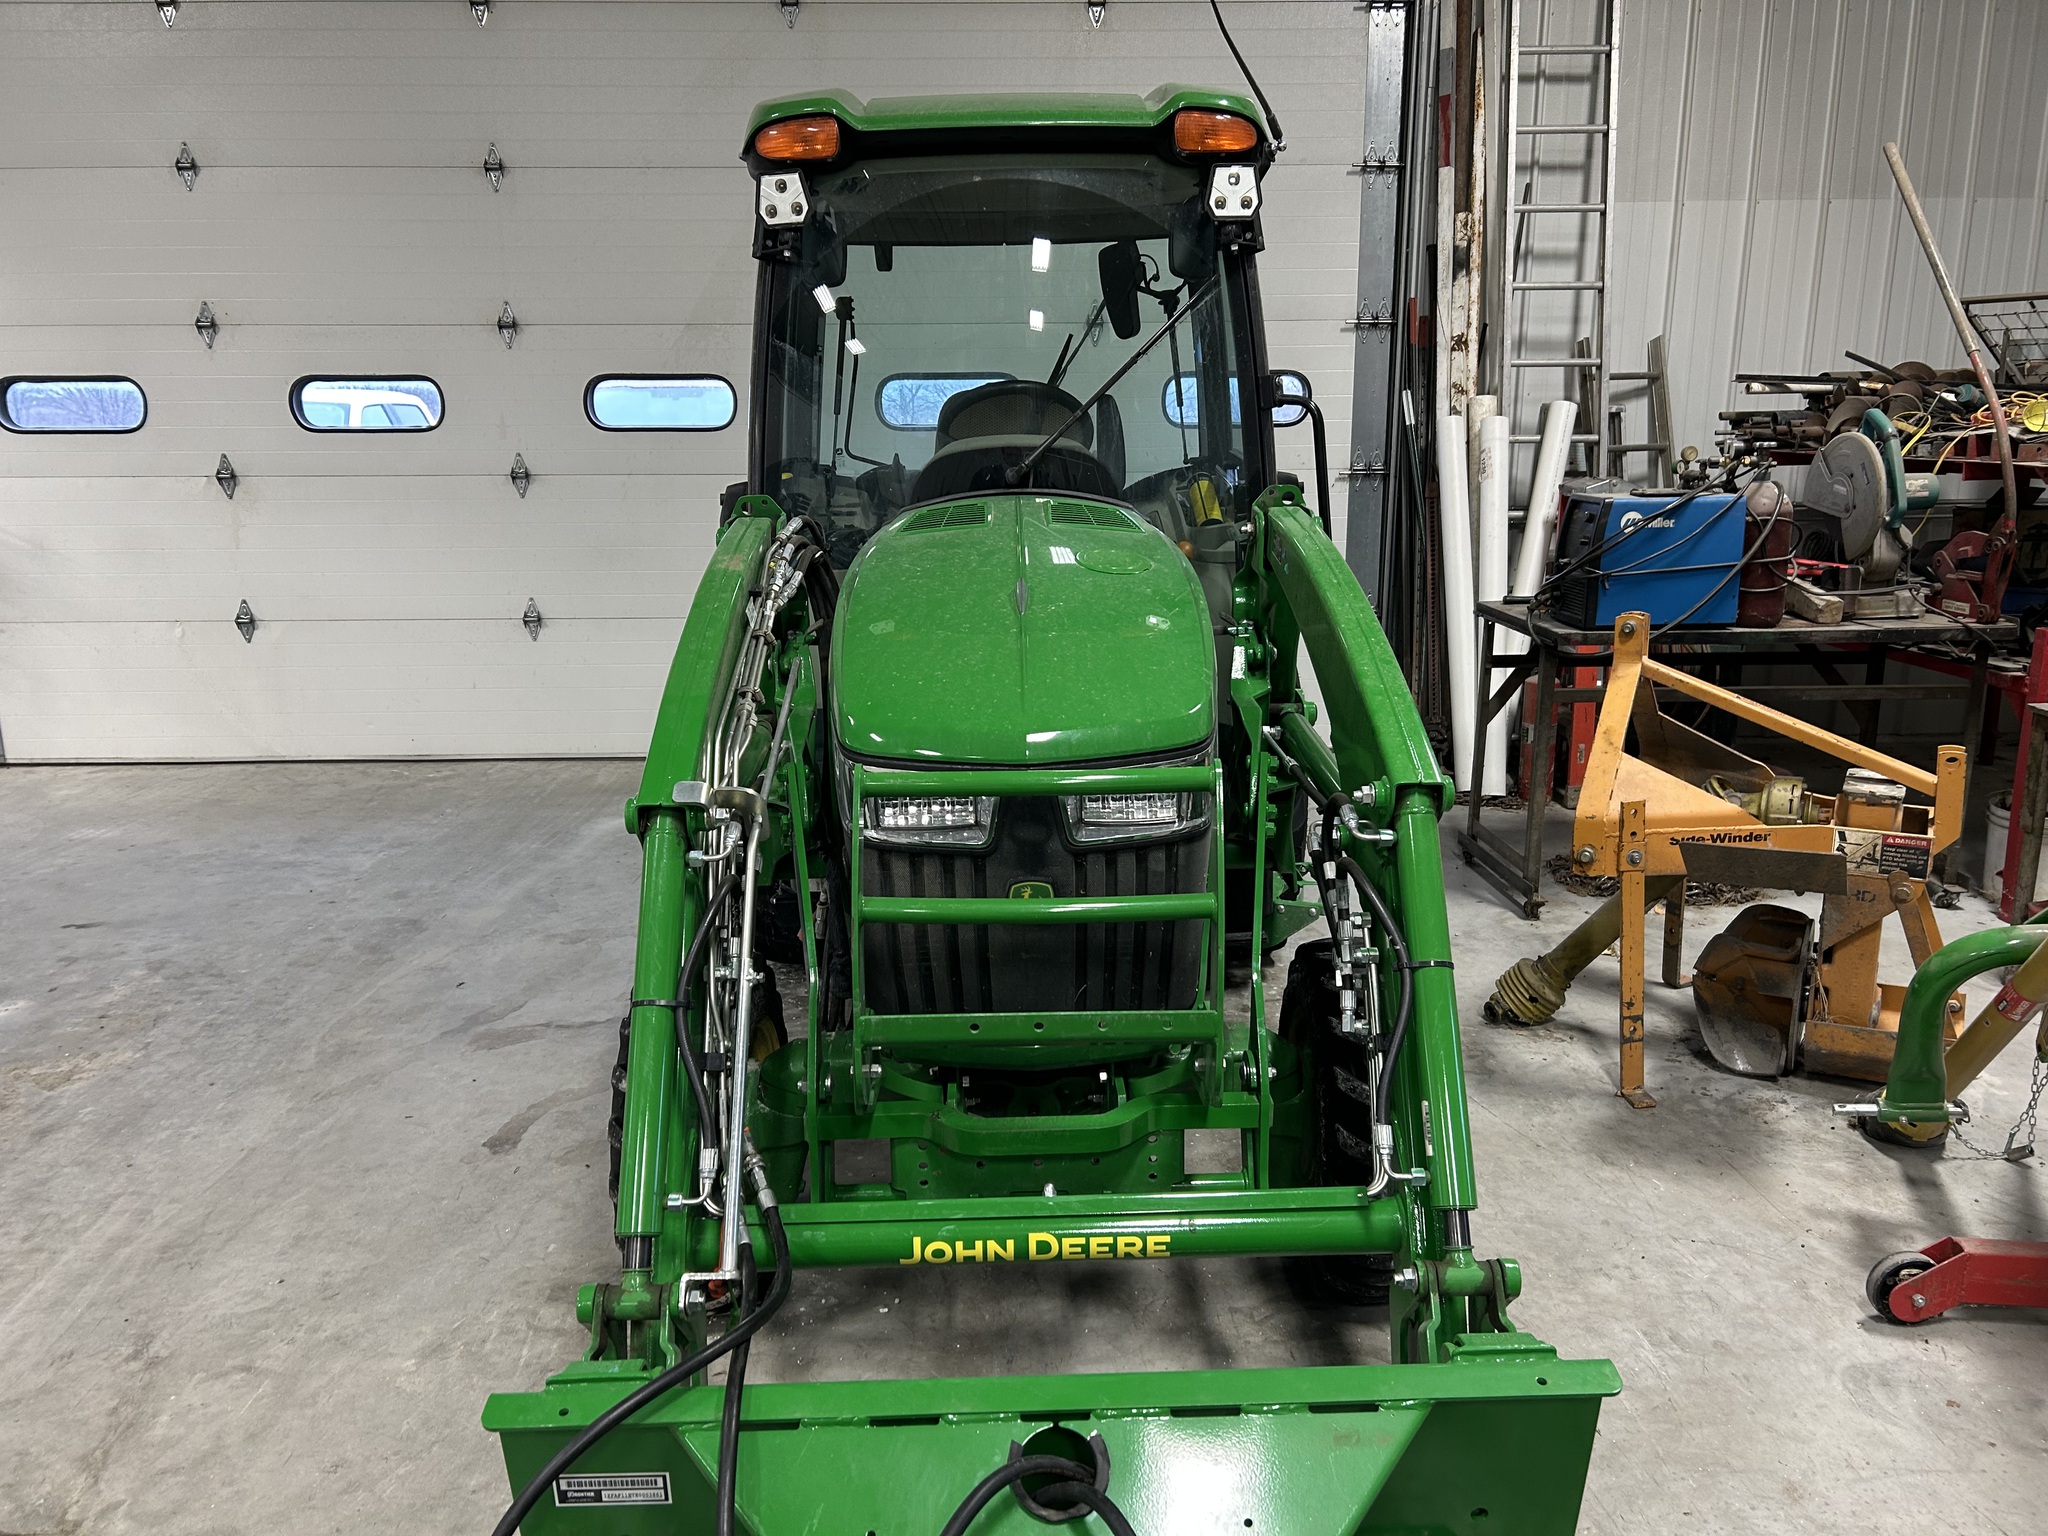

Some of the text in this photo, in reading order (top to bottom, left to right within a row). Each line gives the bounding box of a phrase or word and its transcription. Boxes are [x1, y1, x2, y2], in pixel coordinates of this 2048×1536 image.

[1895, 838, 1927, 846] DANGER
[900, 1232, 1171, 1265] JOHN DEERE
